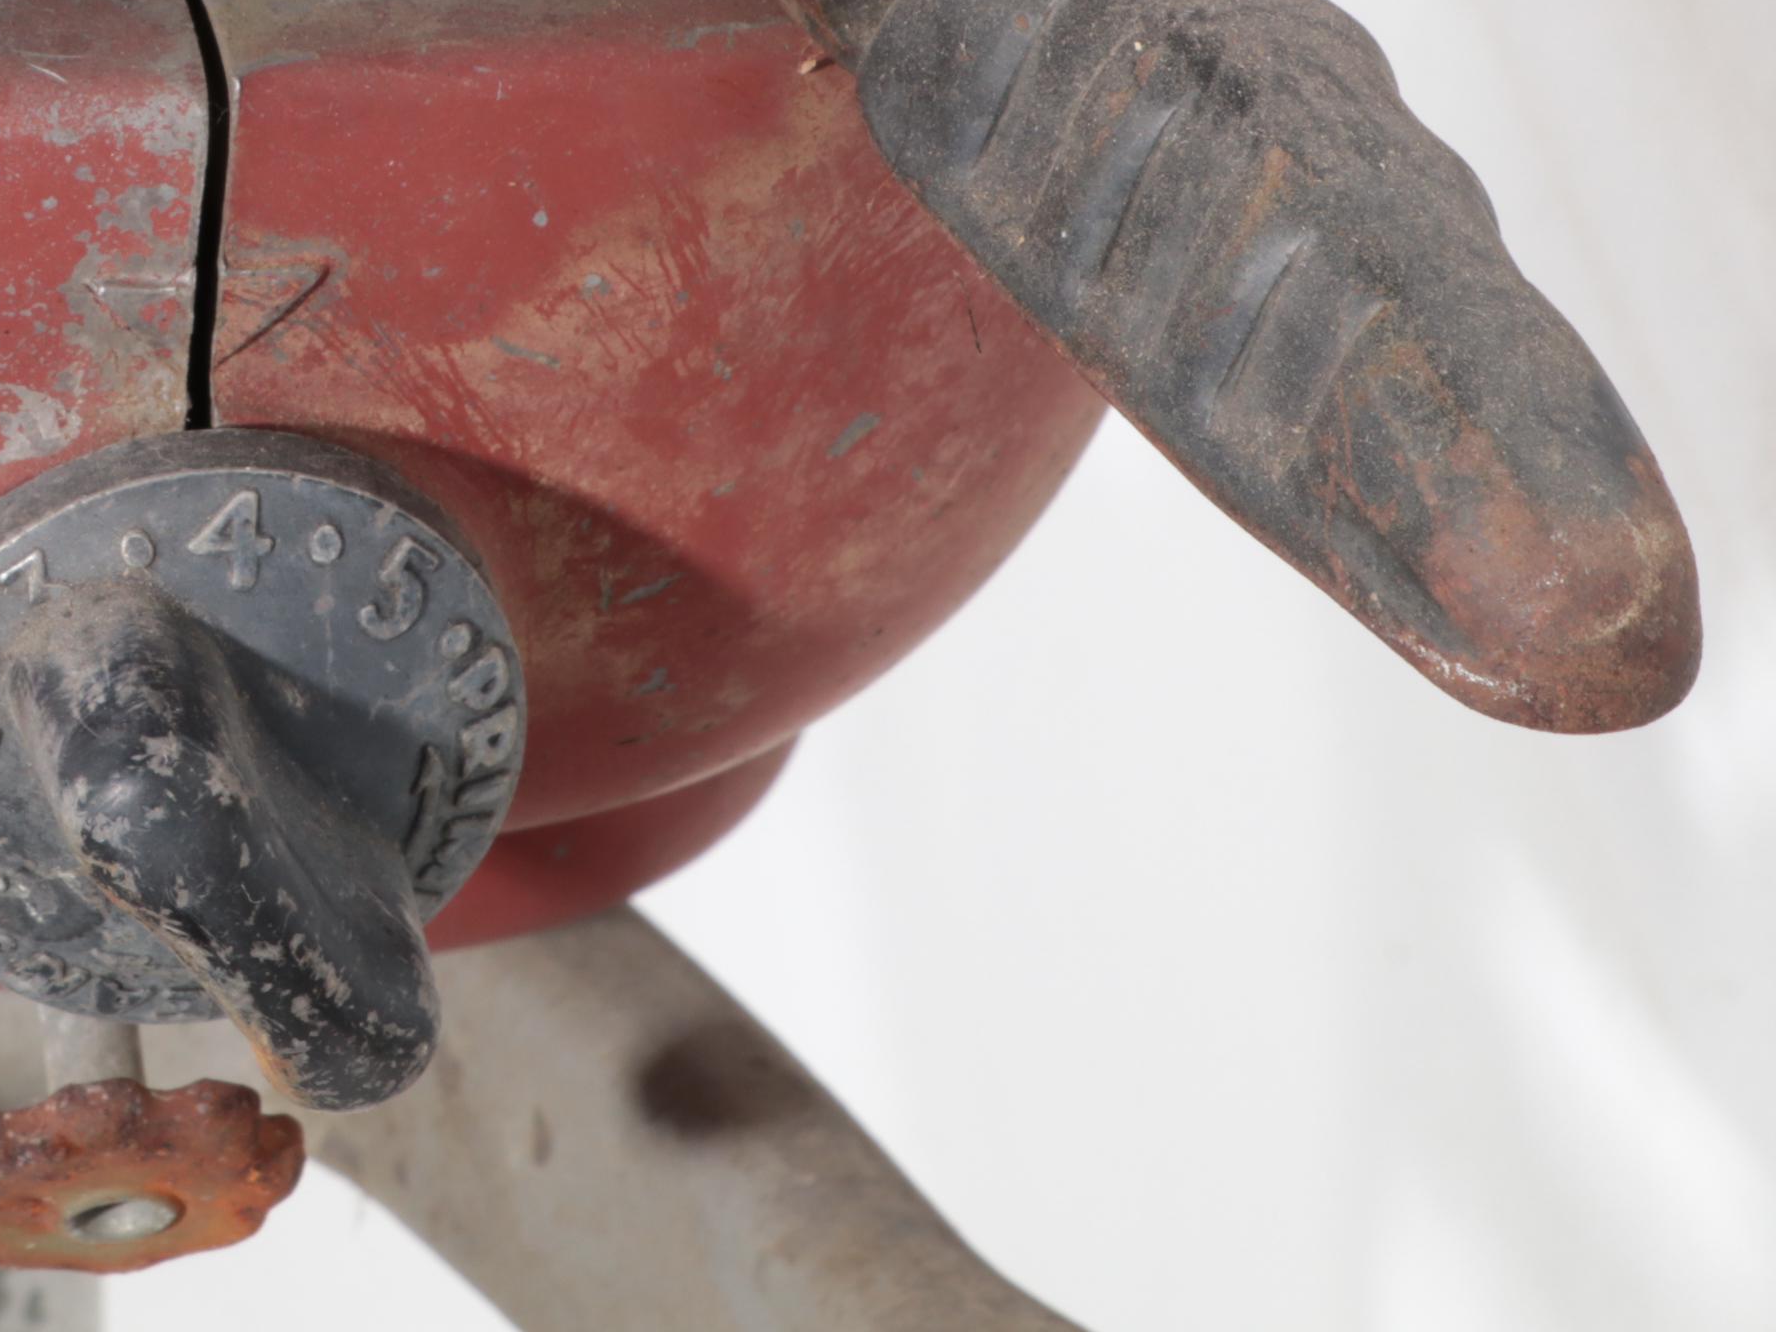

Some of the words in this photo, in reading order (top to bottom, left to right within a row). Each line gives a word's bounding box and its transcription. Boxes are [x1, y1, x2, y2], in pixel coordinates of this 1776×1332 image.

[11, 948, 209, 1019] EAN
[187, 488, 274, 590] 4
[359, 535, 441, 641] 5
[414, 644, 521, 898] PRIM
